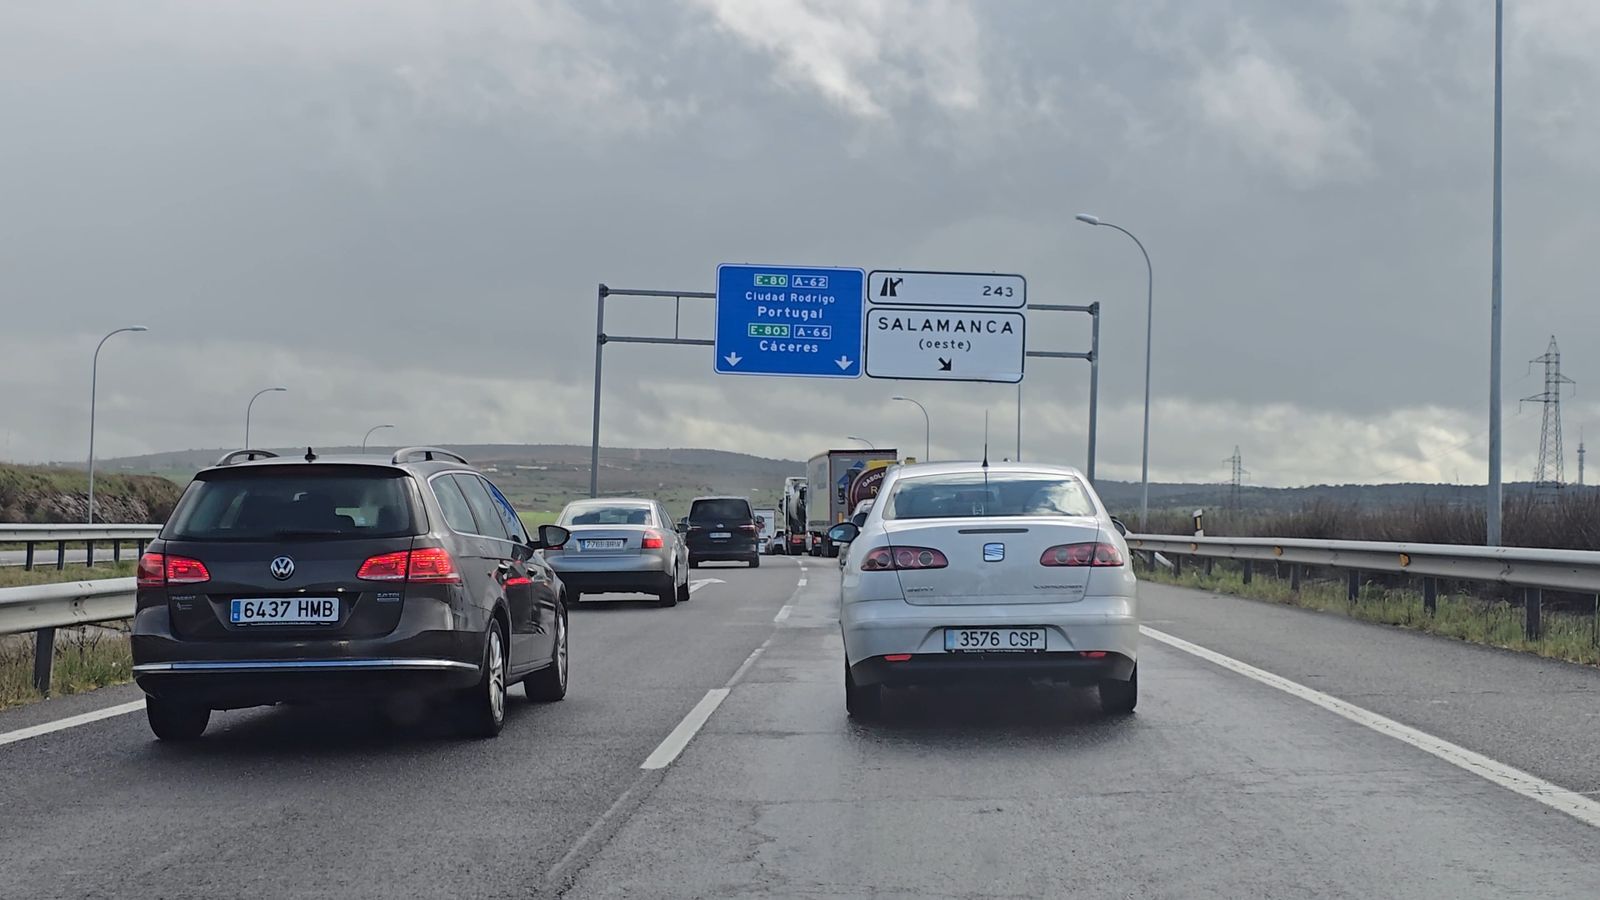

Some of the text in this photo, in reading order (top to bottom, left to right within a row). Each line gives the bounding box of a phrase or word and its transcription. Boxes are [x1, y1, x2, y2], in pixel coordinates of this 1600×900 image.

[756, 276, 826, 287] E-80 A-62
[745, 291, 835, 305] Ciudad Rodrigo
[983, 285, 1014, 297] 243
[757, 306, 823, 321] Portugal
[750, 325, 829, 337] E-803 A-66
[878, 317, 1013, 334] SALAMANCA
[760, 340, 819, 353] Cáceres
[918, 338, 972, 352] (oeste)
[244, 601, 291, 618] 6437
[298, 600, 333, 617] HMB
[960, 631, 1039, 647] 3576 CSP
